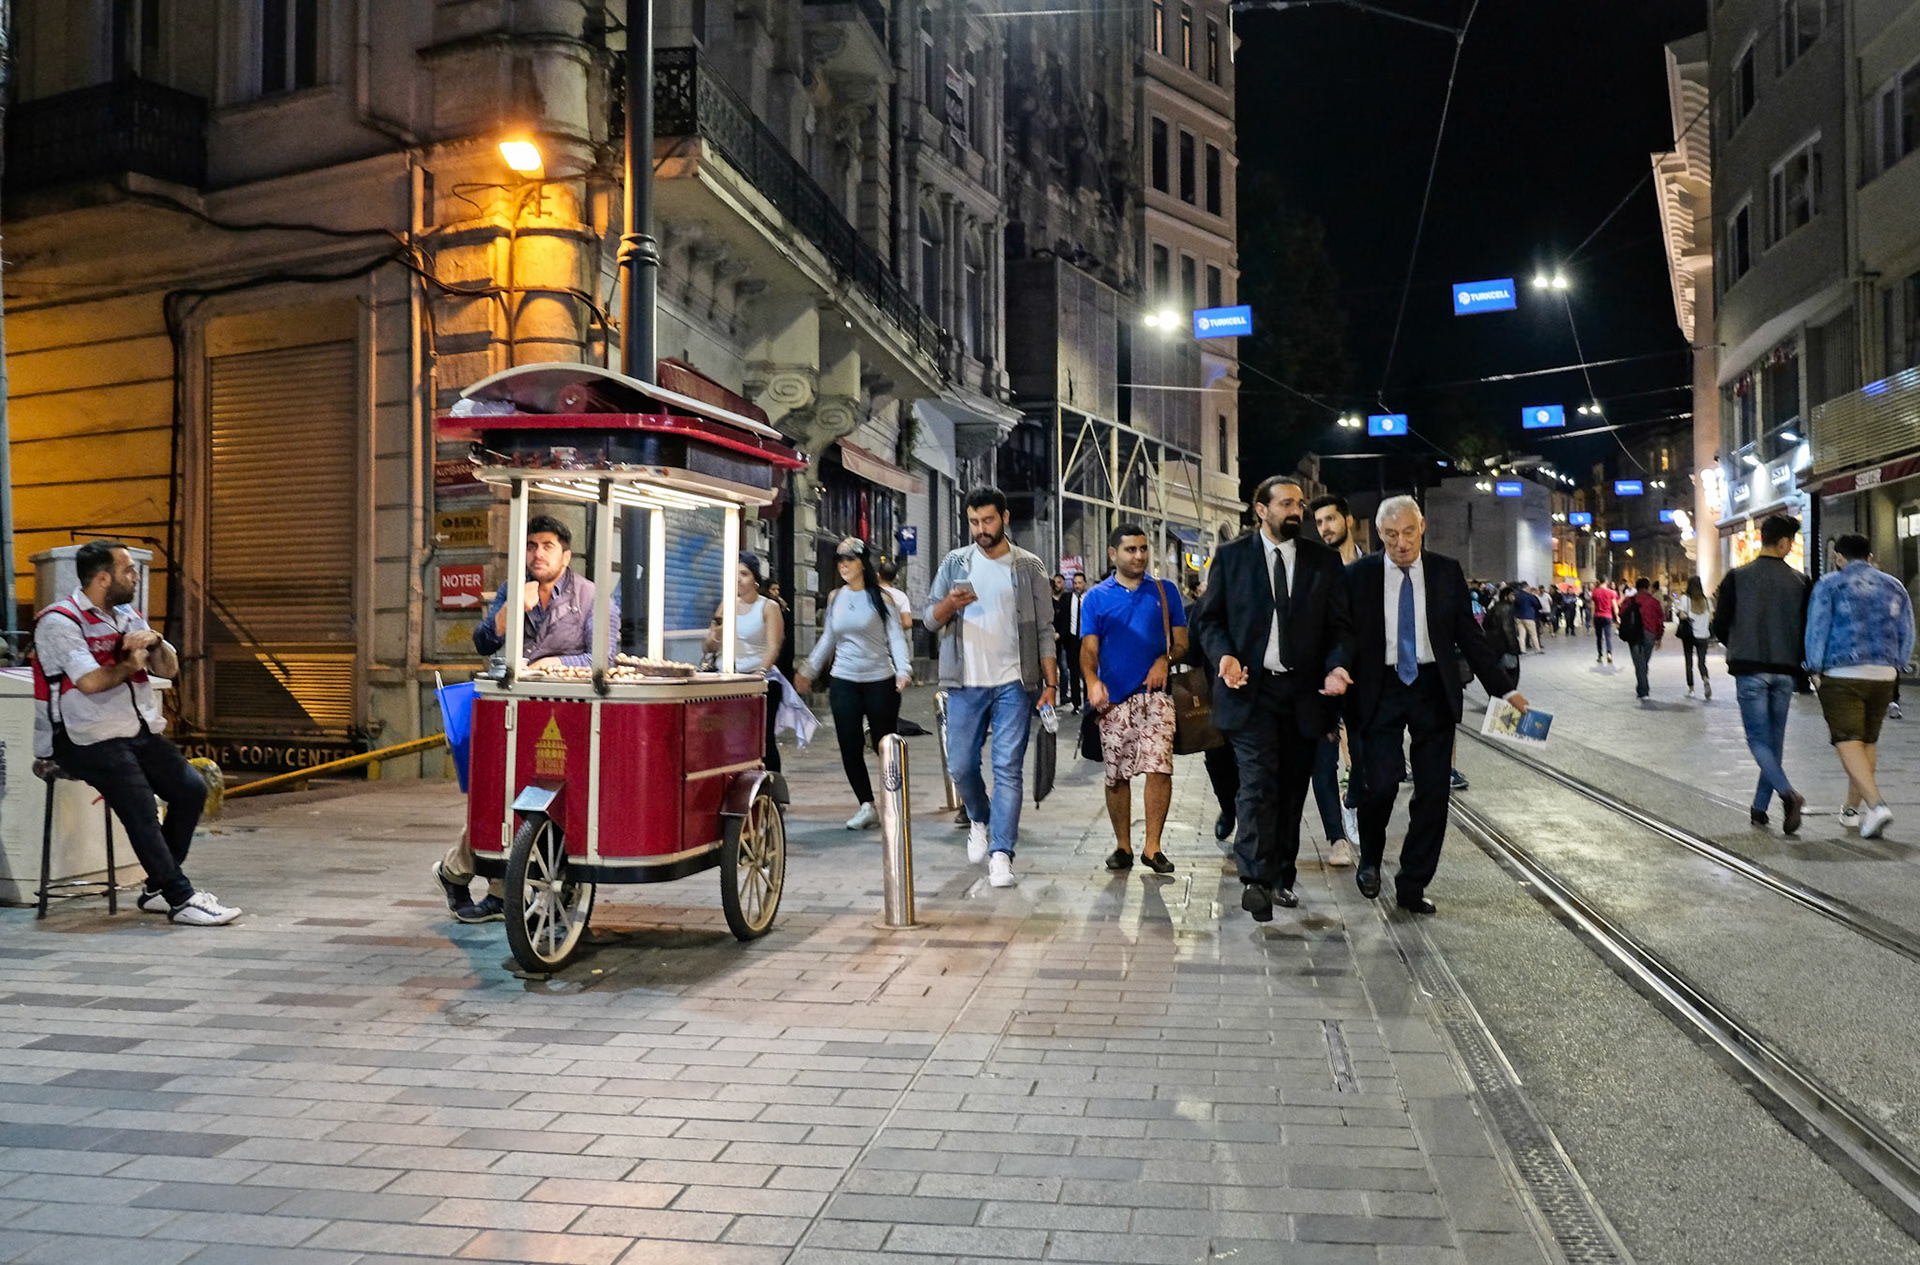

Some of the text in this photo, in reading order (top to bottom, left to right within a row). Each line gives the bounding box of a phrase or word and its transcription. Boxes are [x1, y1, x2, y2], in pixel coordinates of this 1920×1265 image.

[1470, 290, 1510, 301] TURKCELL
[1210, 316, 1247, 328] TURKCELL
[442, 574, 481, 588] NOTER
